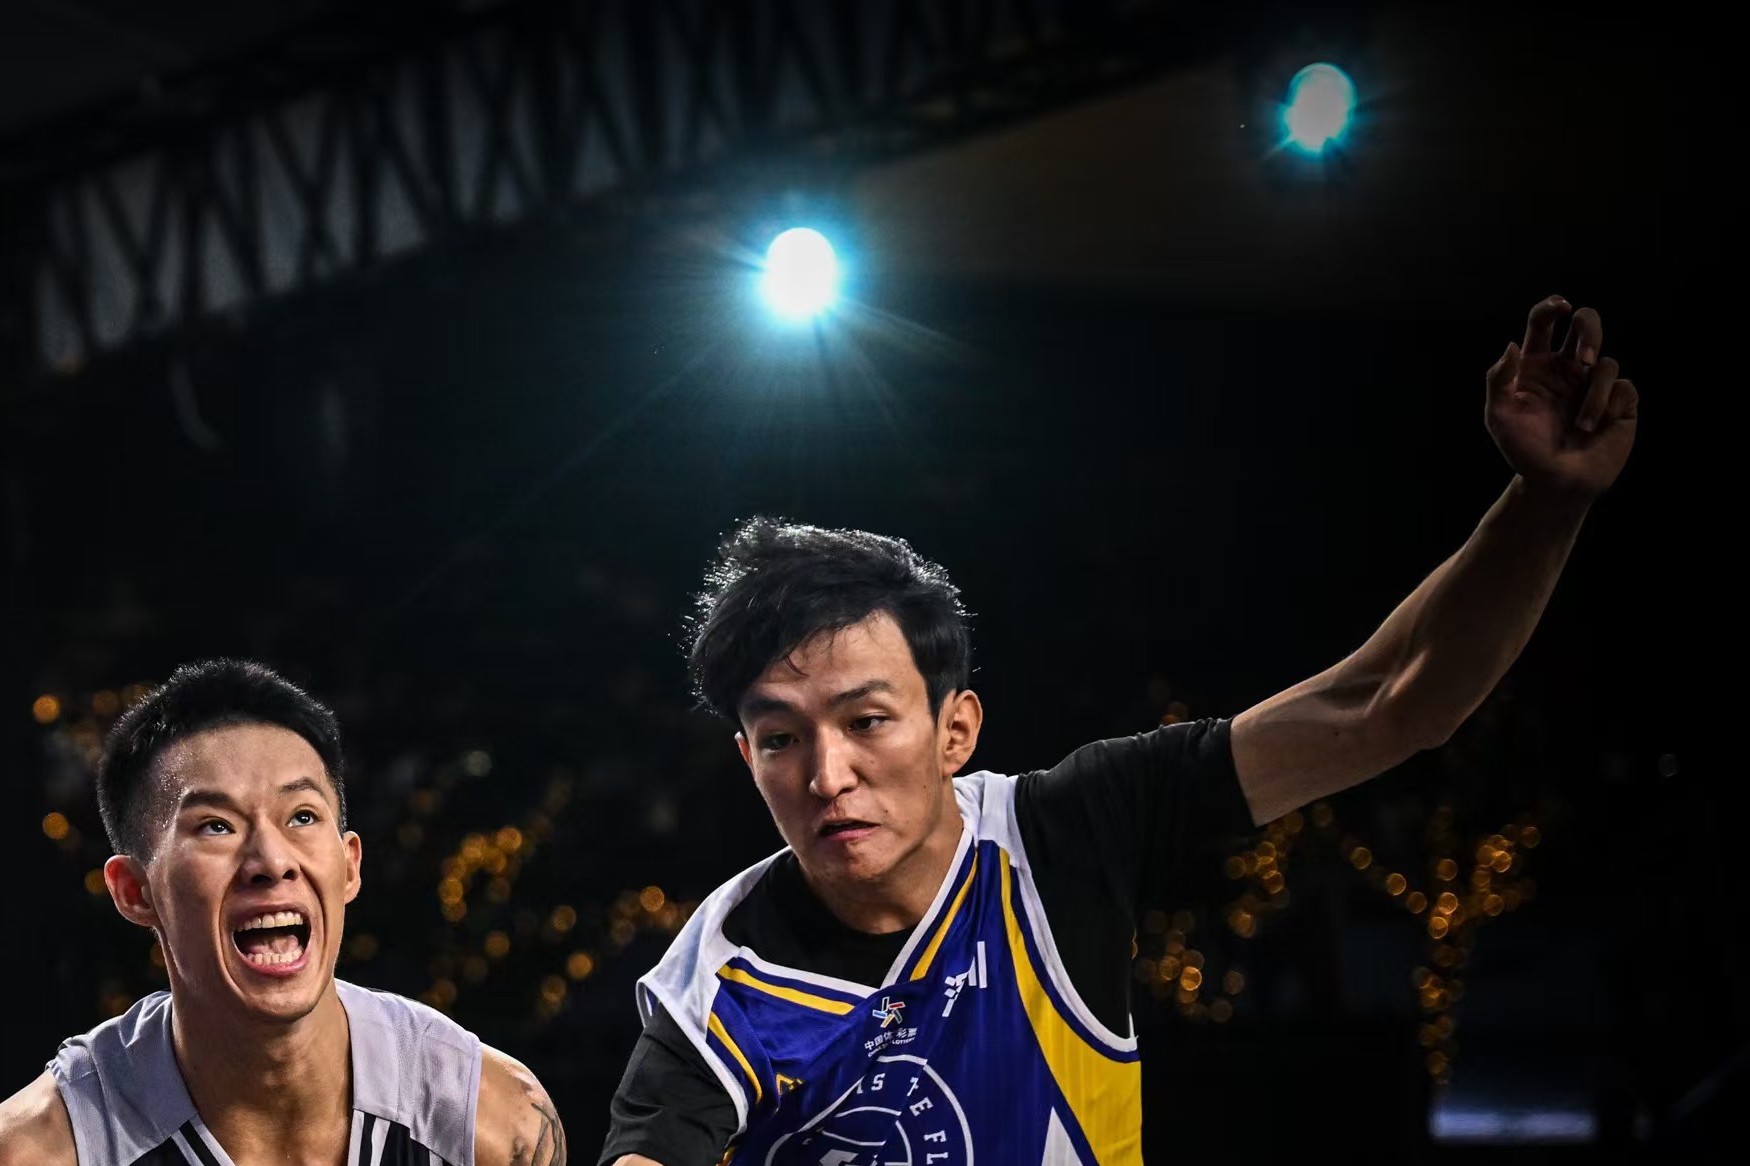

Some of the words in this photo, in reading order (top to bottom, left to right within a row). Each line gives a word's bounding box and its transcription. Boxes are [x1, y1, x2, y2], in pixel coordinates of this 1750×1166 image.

[864, 1027, 918, 1051] 中国体彩票
